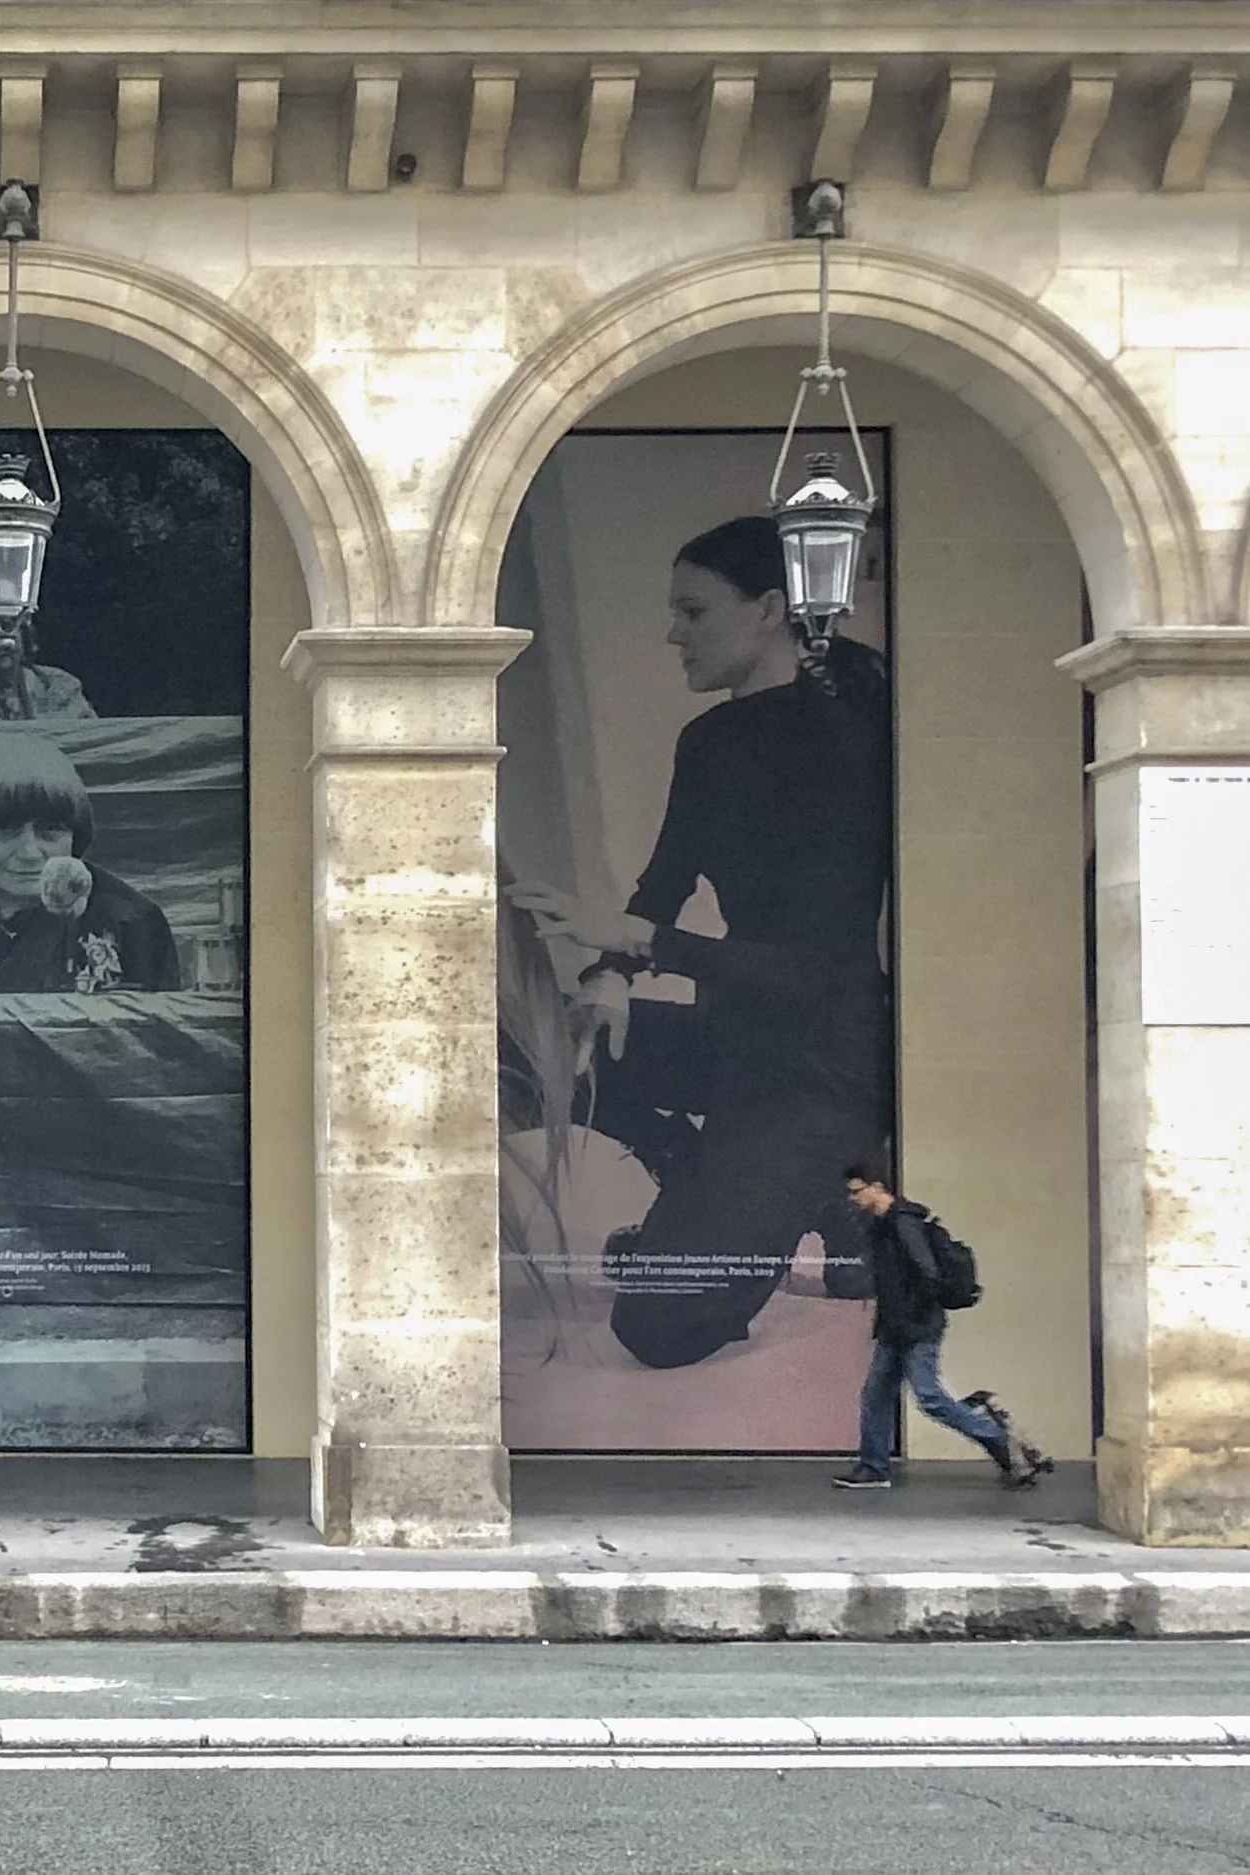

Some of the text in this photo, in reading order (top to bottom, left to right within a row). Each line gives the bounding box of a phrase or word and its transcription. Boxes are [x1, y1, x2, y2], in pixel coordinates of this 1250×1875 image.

[619, 1253, 630, 1263] de
[631, 1253, 682, 1264] l'exposition
[84, 1263, 130, 1273] septembre
[622, 1267, 643, 1277] pour
[754, 1267, 775, 1278] 2019
